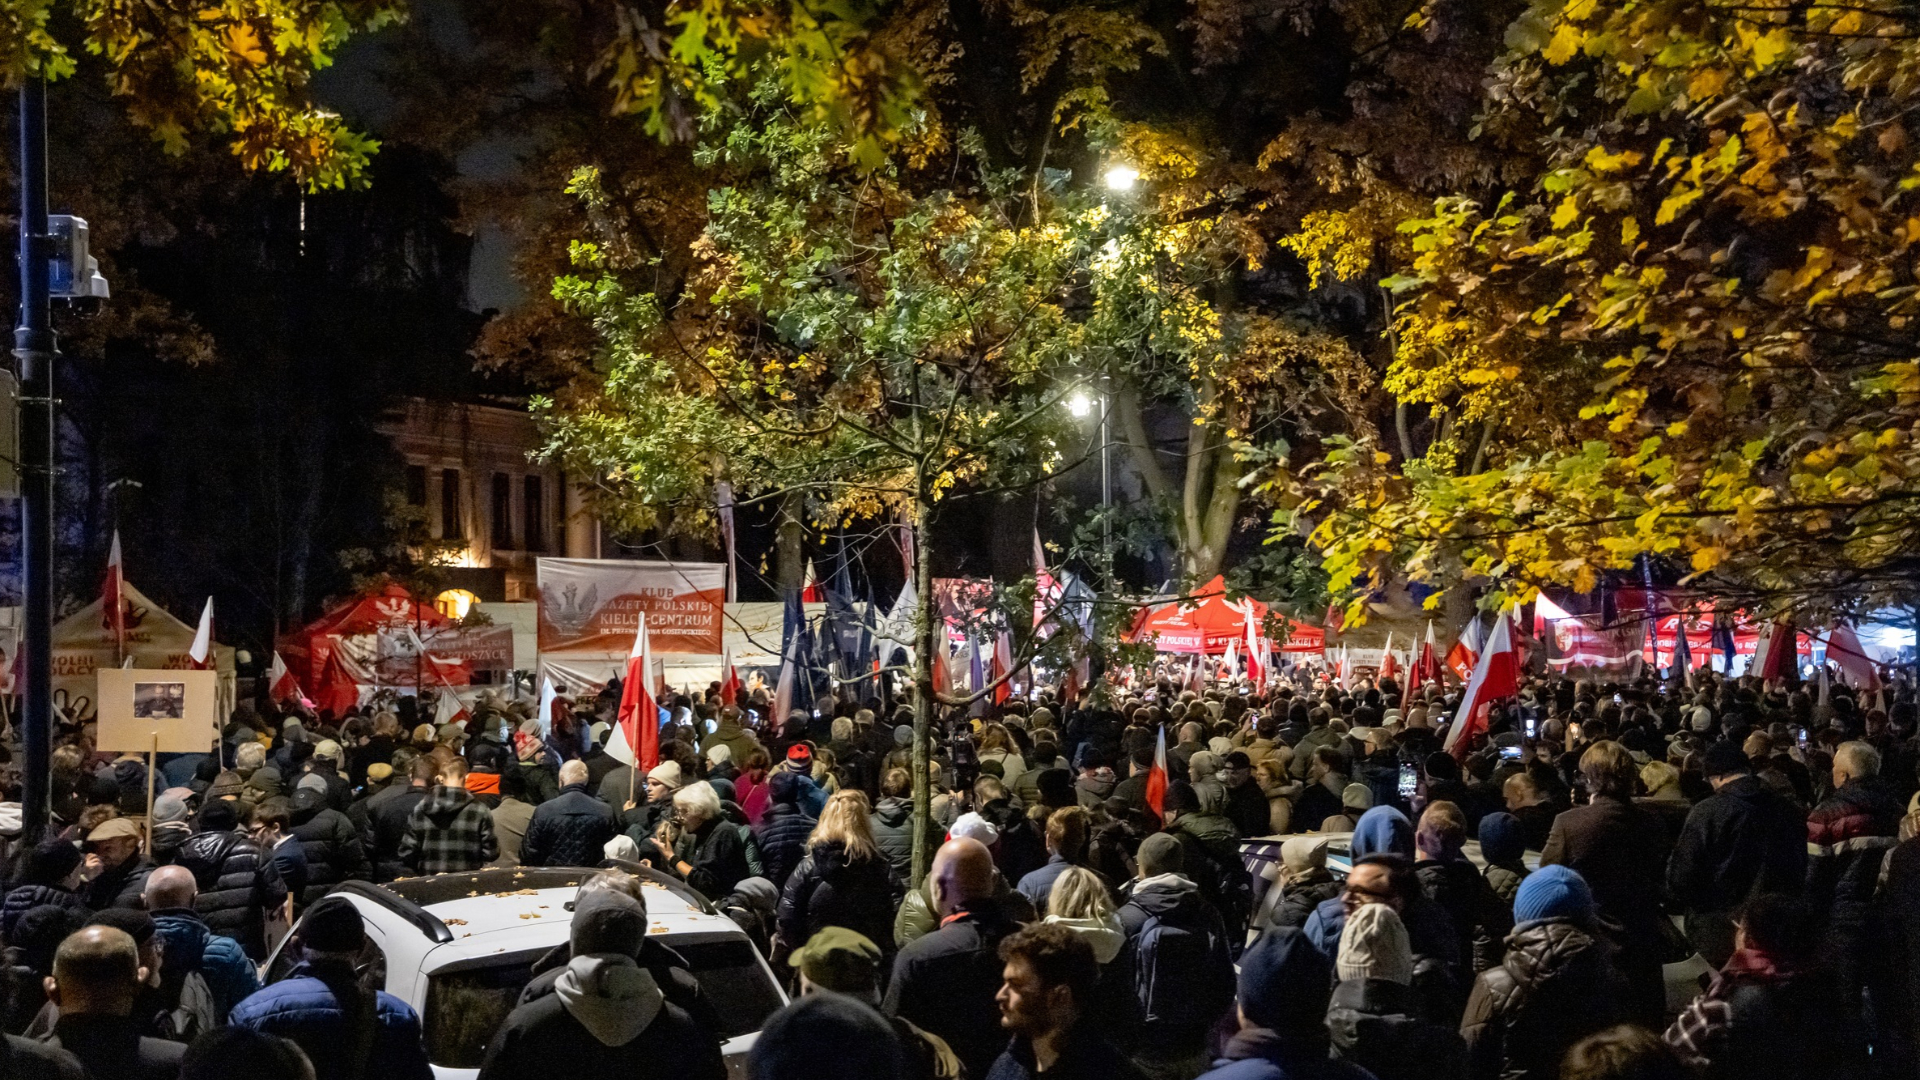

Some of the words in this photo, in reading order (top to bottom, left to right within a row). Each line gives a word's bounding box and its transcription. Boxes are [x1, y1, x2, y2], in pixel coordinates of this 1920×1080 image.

[641, 587, 674, 598] KLUB
[602, 600, 649, 610] GAZETY
[655, 600, 712, 612] POLSKIEJ
[601, 613, 712, 625] KIELC-CENTRUM
[51, 655, 94, 666] OLNI
